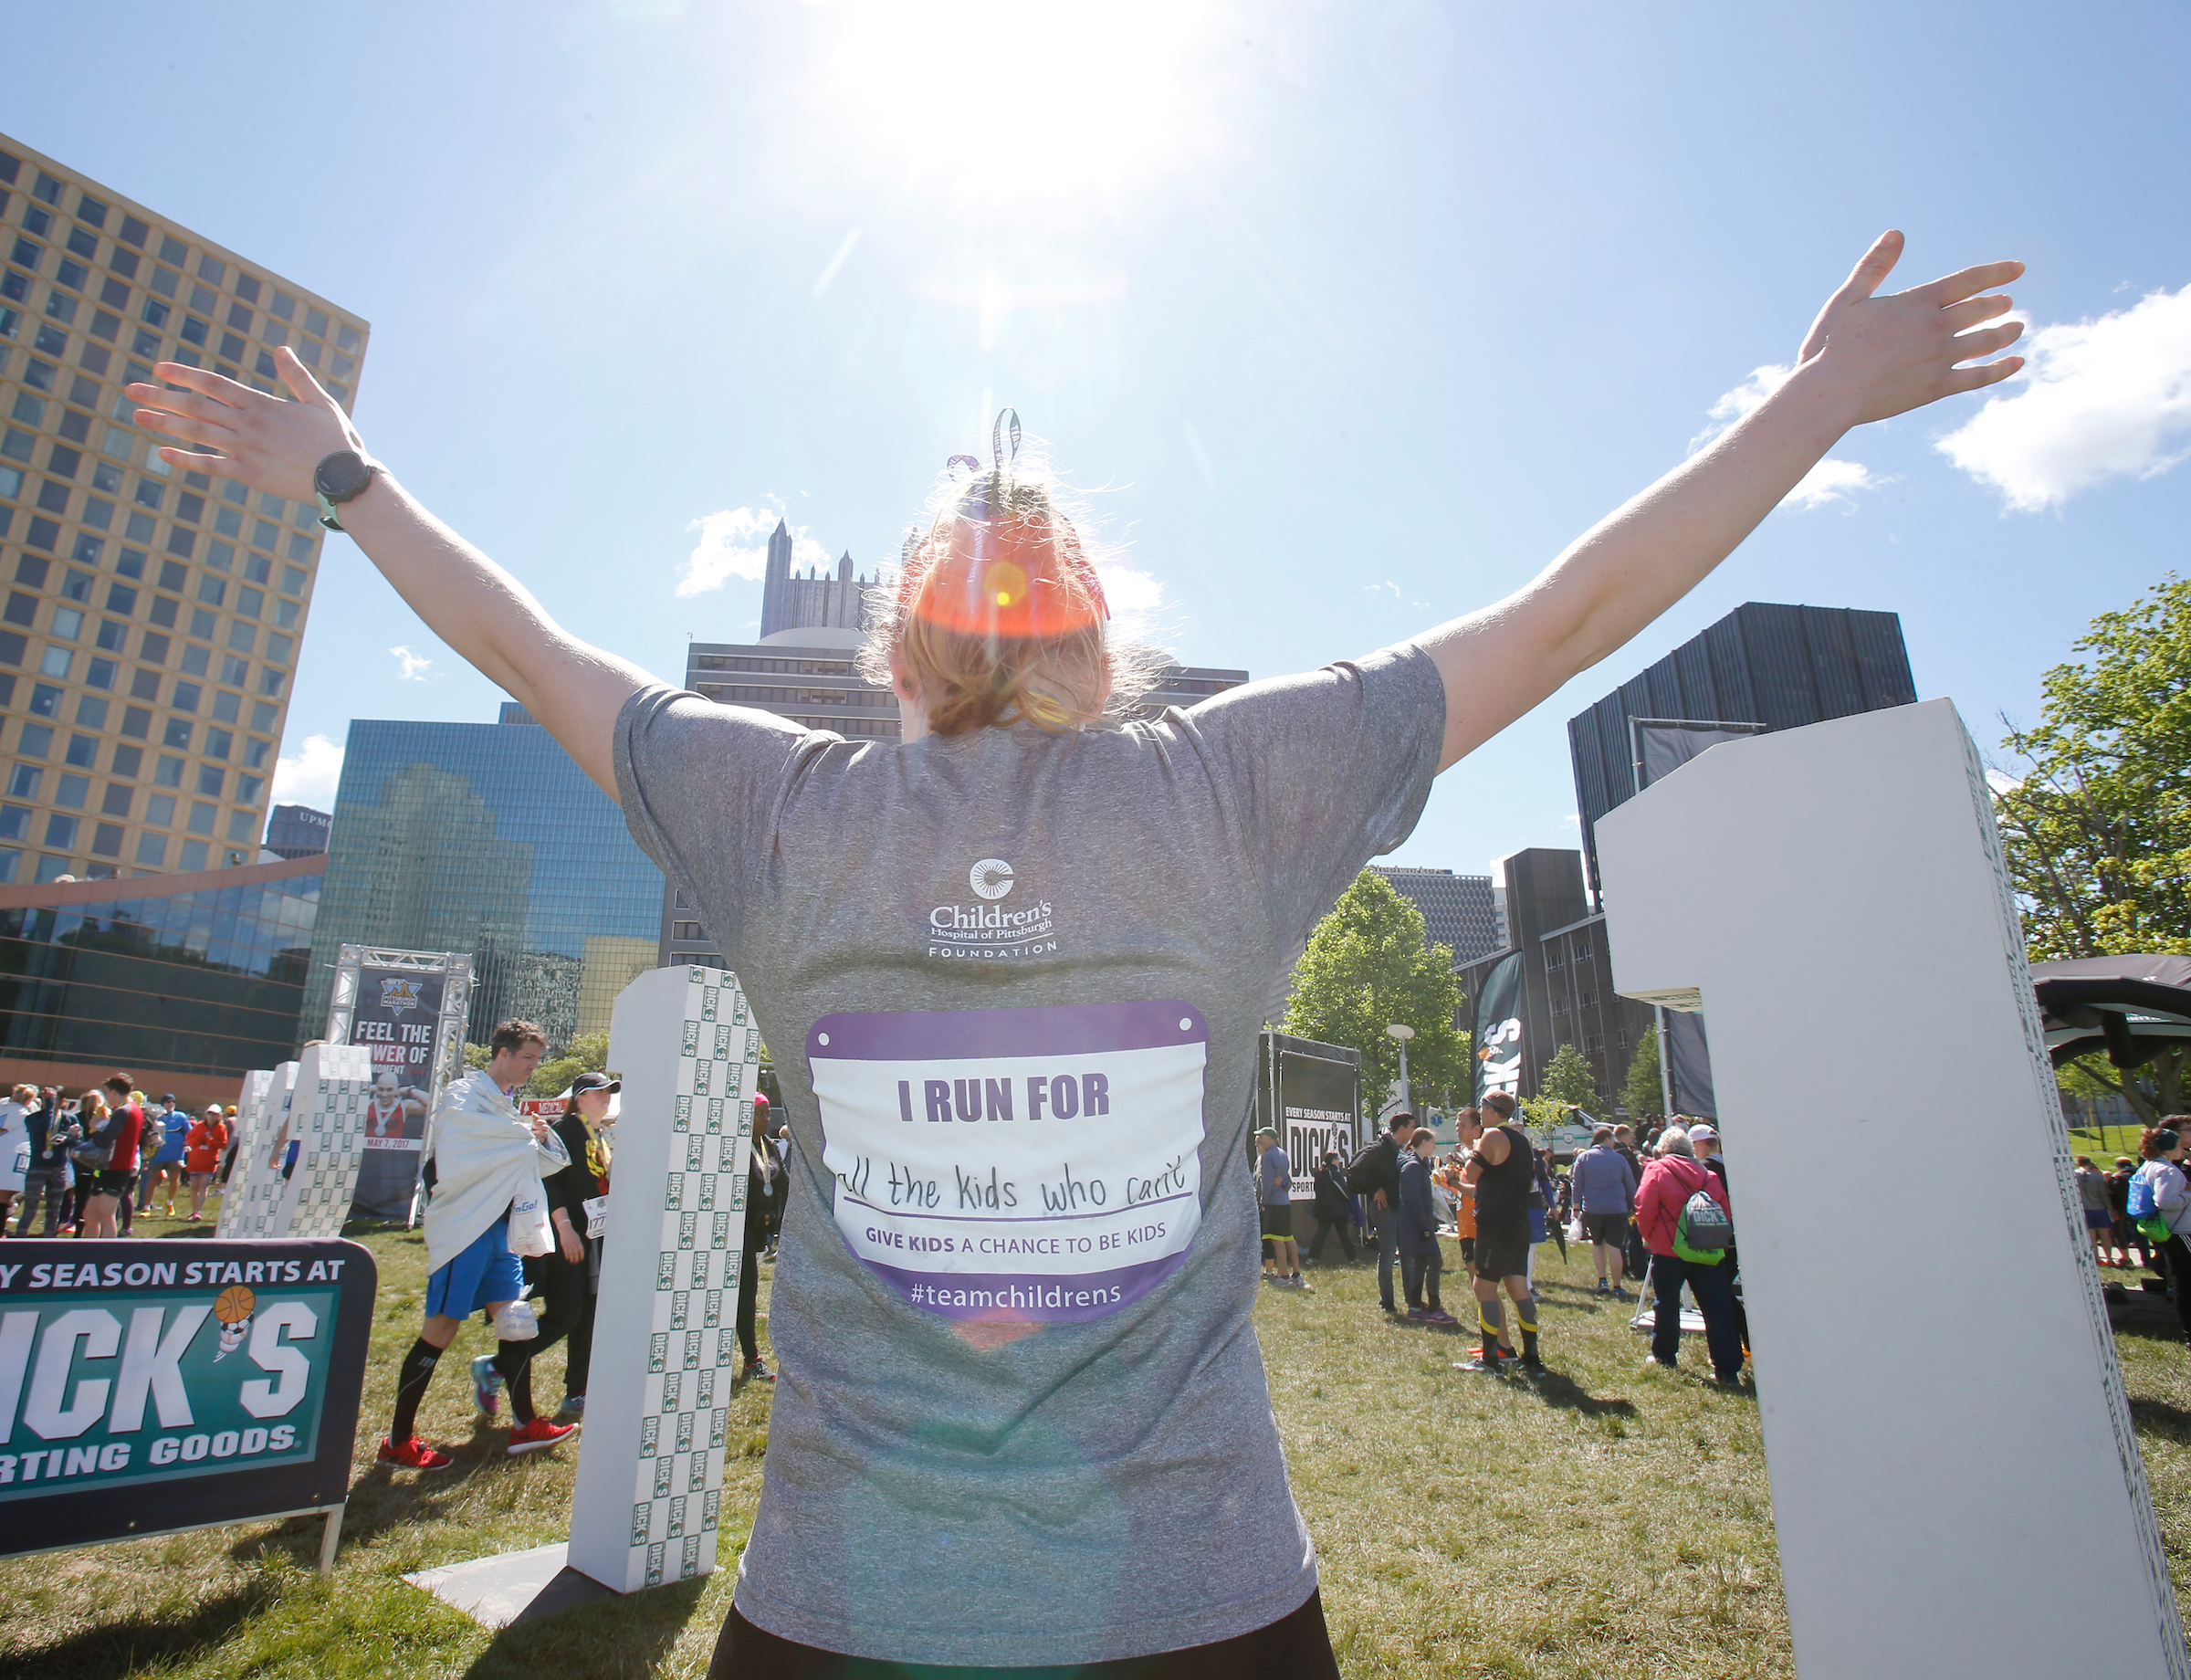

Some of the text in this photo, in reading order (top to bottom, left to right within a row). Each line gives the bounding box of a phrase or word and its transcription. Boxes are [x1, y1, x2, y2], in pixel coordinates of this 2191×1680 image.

[930, 898, 1052, 929] Children's
[931, 919, 1052, 940] Hospital of Pittsburgh
[929, 940, 1057, 958] FOUNDATION
[706, 987, 718, 1021] DICK'S
[356, 1021, 432, 1044] FEEL THE
[685, 1022, 697, 1056] DICK'S
[717, 1025, 729, 1060] DICK'S
[748, 1030, 759, 1063] DICK'S
[409, 1046, 429, 1065] OF
[697, 1060, 709, 1095] DICK'S
[729, 1064, 740, 1097] DICK'S
[538, 1101, 562, 1114] MEDICAL
[677, 1097, 690, 1131] DICK'S
[897, 1072, 1109, 1123] I RUN FOR
[1285, 1107, 1351, 1122] EVERY SEASON STARTS AT
[710, 1099, 721, 1134] DICK'S
[740, 1102, 752, 1136] DICK'S
[367, 1138, 410, 1149] MAY 7, 2017
[690, 1136, 702, 1171] DICK'S
[722, 1138, 734, 1172] DICK'S
[1291, 1122, 1349, 1177] DICK'S
[669, 1174, 682, 1210] DICK'S
[702, 1175, 715, 1210] DICK'S
[734, 1176, 746, 1211] DICK'S
[887, 1161, 940, 1209] the
[955, 1164, 1017, 1210] kids
[1042, 1163, 1106, 1211] who
[681, 1213, 694, 1249] DICK'S
[715, 1213, 727, 1248] DICK'S
[1693, 1210, 1727, 1222] DICK'S
[865, 1222, 1167, 1255] GIVE KIDS A CHANCE TO BE KIDS
[28, 1262, 177, 1288] SEASON
[184, 1261, 300, 1284] STARTS
[307, 1260, 345, 1282] AT
[661, 1253, 674, 1290] DICK'S
[695, 1253, 707, 1288] DICK'S
[727, 1252, 739, 1287] DICK'S
[674, 1292, 687, 1329] DICK'S
[708, 1291, 719, 1327] DICK'S
[911, 1283, 1121, 1308] #teamchildrens
[652, 1334, 666, 1372] DICK'S
[687, 1332, 699, 1369] DICK'S
[719, 1329, 732, 1366] DICK'S
[666, 1373, 679, 1412] DICK'S
[700, 1371, 712, 1408] DICK'S
[150, 1424, 296, 1465] GOODS
[644, 1418, 657, 1457] DICK'S
[679, 1413, 692, 1452] DICK'S
[712, 1409, 726, 1446] DICK'S
[657, 1458, 671, 1496] DICK'S
[692, 1453, 705, 1490] DICK'S
[635, 1504, 649, 1544] DICK'S
[671, 1497, 684, 1537] DICK'S
[705, 1491, 718, 1530] DICK'S
[649, 1544, 663, 1585] DICK'S
[684, 1536, 697, 1576] DICK'S
